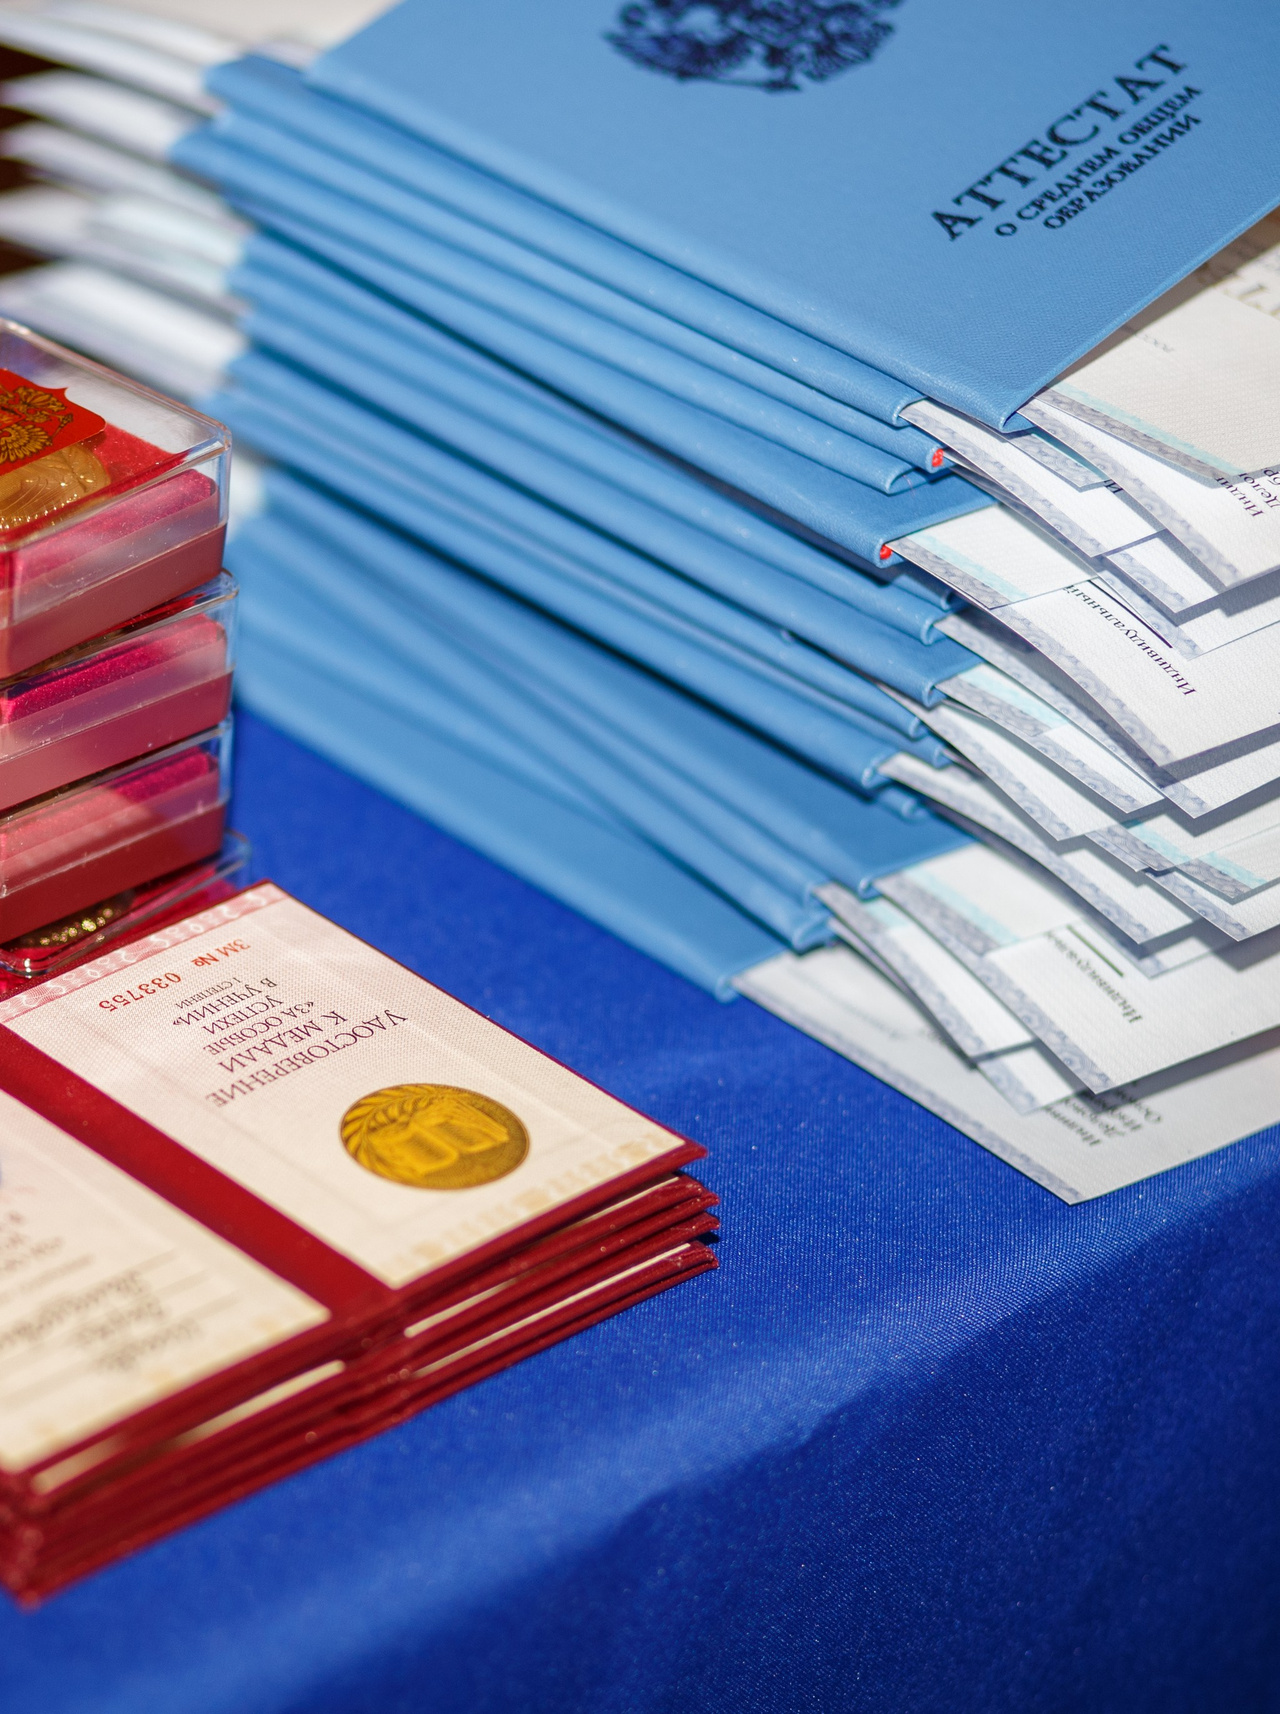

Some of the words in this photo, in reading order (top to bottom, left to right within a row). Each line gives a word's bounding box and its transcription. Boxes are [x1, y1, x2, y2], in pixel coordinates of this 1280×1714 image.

[931, 43, 1189, 242] АТТЕСТАТ
[994, 222, 1019, 238] О
[1015, 145, 1121, 221] СРЕДНЕМ
[1117, 85, 1203, 146] ОБЩЕМ
[1042, 112, 1203, 230] ОБРАЗОВАНИИ
[1062, 584, 1197, 696] Индивидуальный
[98, 971, 183, 1013] 033755
[175, 980, 234, 1010] СТЕПЕНИ
[259, 976, 278, 989] В
[172, 983, 263, 1026] УЧЕНИИ»
[202, 994, 284, 1035] УСПЕХИ
[280, 1000, 315, 1020] «ЗА
[320, 1010, 349, 1026] К
[203, 1015, 283, 1056] ОСОБЫЕ
[217, 1020, 324, 1074] МЕДАЛИ
[206, 1008, 409, 1108] УДОСТОВЕРЕНИЕ
